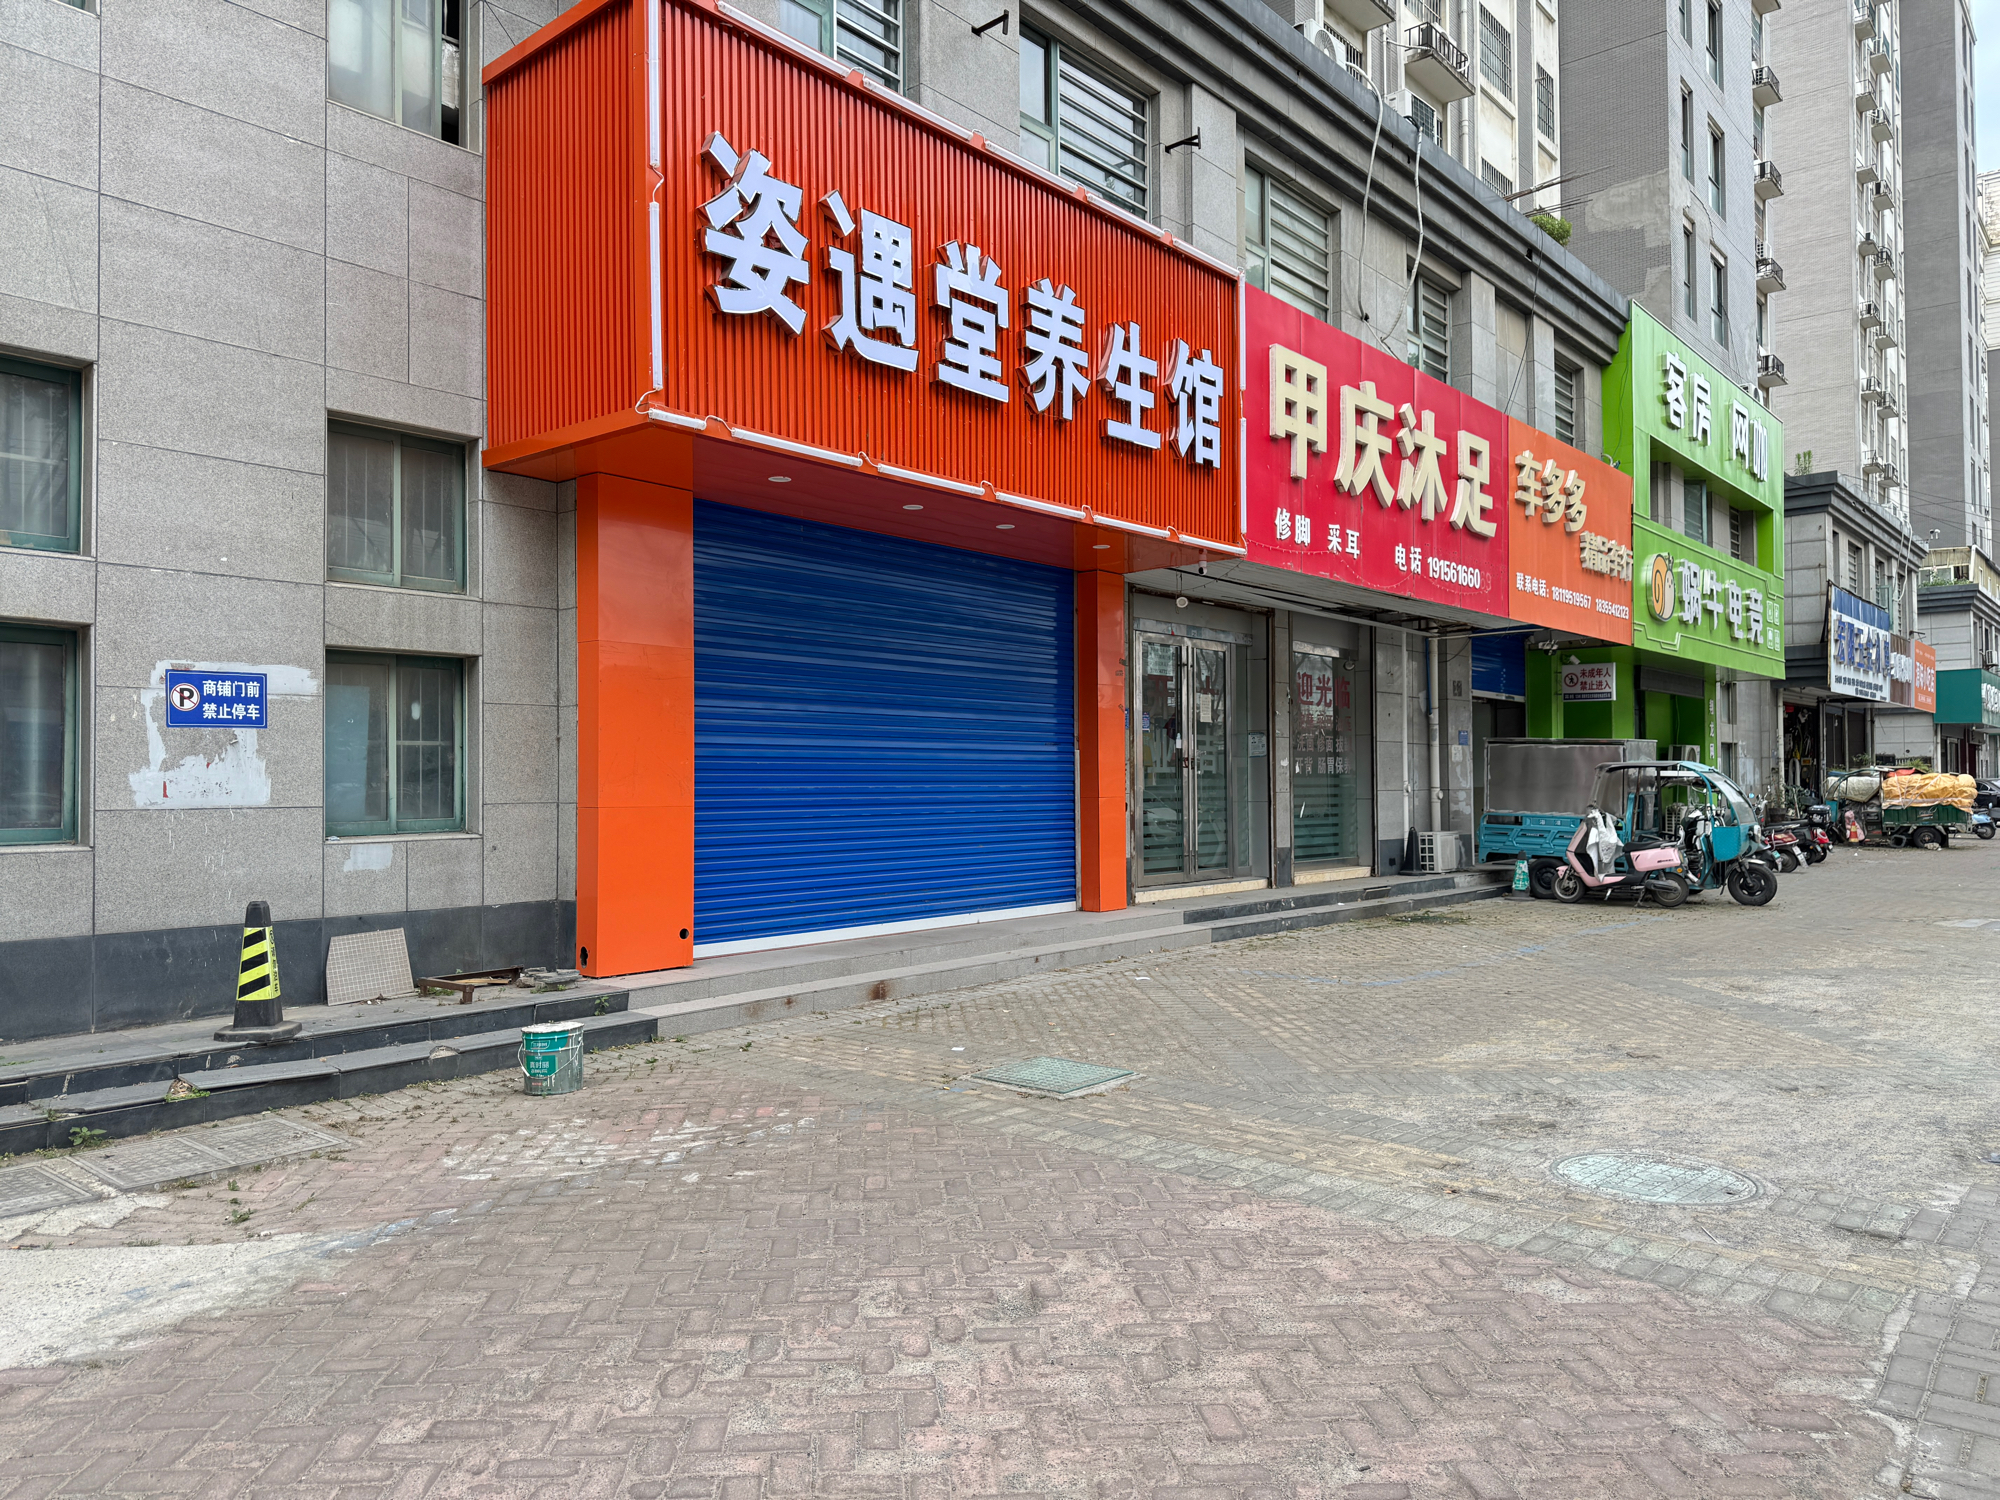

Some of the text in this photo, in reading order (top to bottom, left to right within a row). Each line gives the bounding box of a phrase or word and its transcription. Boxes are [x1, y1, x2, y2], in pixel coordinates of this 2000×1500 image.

[699, 131, 1224, 469] 姿遇堂养生馆
[1269, 344, 1496, 537] 甲庆沐足
[1664, 351, 1767, 482] 客房 网咖
[1515, 450, 1587, 532] 车多多
[1275, 507, 1311, 546] 修脚
[1327, 524, 1360, 559] 采耳
[1395, 544, 1422, 575] 电话
[1580, 531, 1632, 581] 精品车行
[1552, 586, 1591, 609] 18119519567
[1596, 598, 1629, 619] 18355412123
[1678, 558, 1764, 644] 蜗牛电竞
[202, 680, 260, 698] 商铺门前
[1296, 672, 1350, 709] 迎光临
[1580, 668, 1611, 679] 未成年人
[1580, 680, 1611, 691] 禁止进入
[202, 702, 260, 720] 禁止停车
